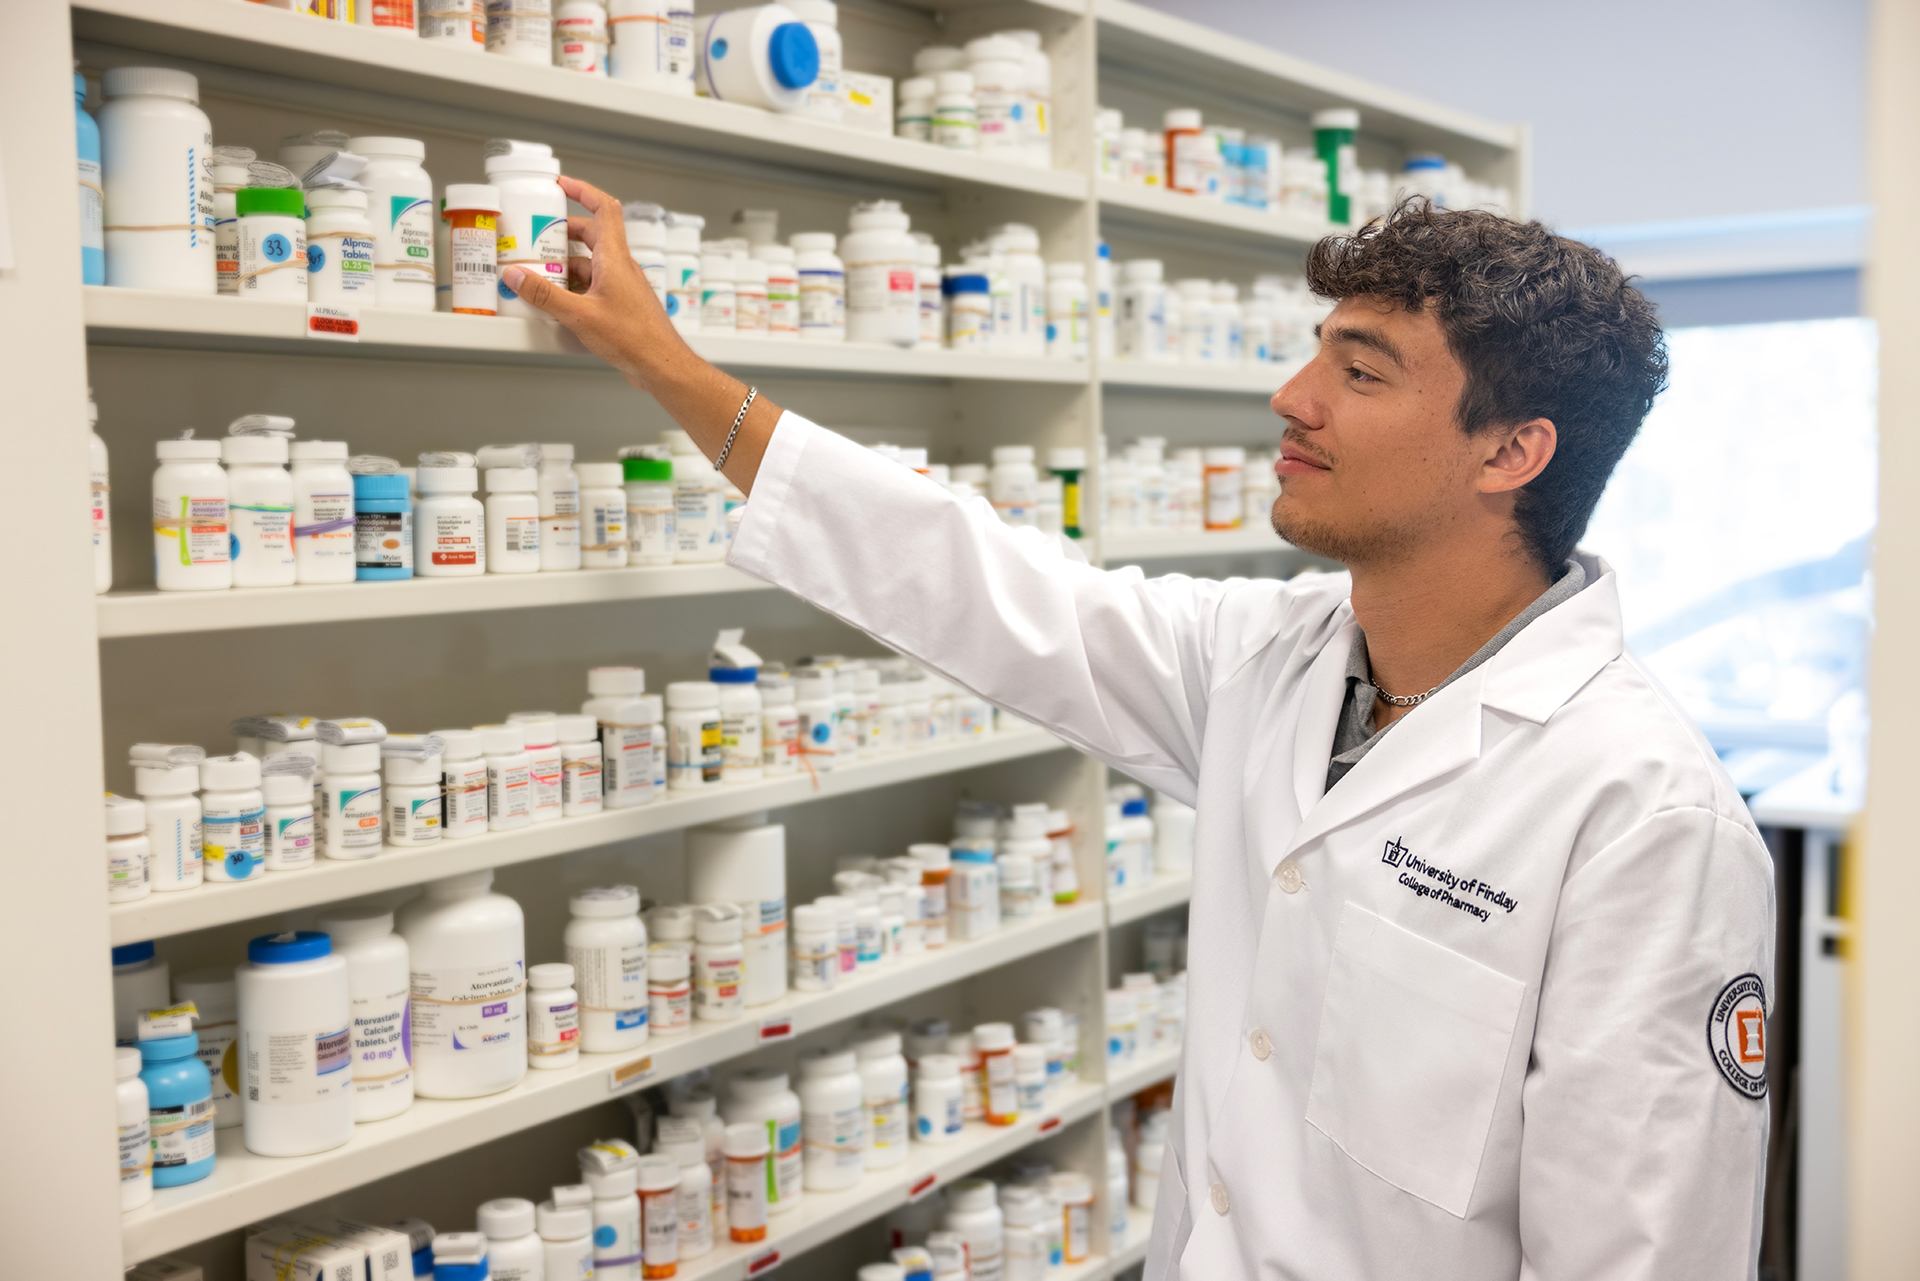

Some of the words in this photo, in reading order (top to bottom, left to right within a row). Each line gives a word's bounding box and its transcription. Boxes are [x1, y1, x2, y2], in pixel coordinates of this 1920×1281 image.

[266, 239, 284, 257] 33
[1398, 872, 1430, 896] College
[1430, 888, 1443, 900] of
[1441, 890, 1491, 922] Pharmacy
[1405, 853, 1461, 890] University
[1460, 879, 1478, 893] of
[1476, 883, 1518, 913] Findlay
[1715, 981, 1752, 1023] UNIVERSITY
[355, 1037, 387, 1048] Tablets,
[363, 1025, 395, 1036] Calcium
[362, 1051, 376, 1061] 40
[1718, 1050, 1749, 1090] COLLEGE
